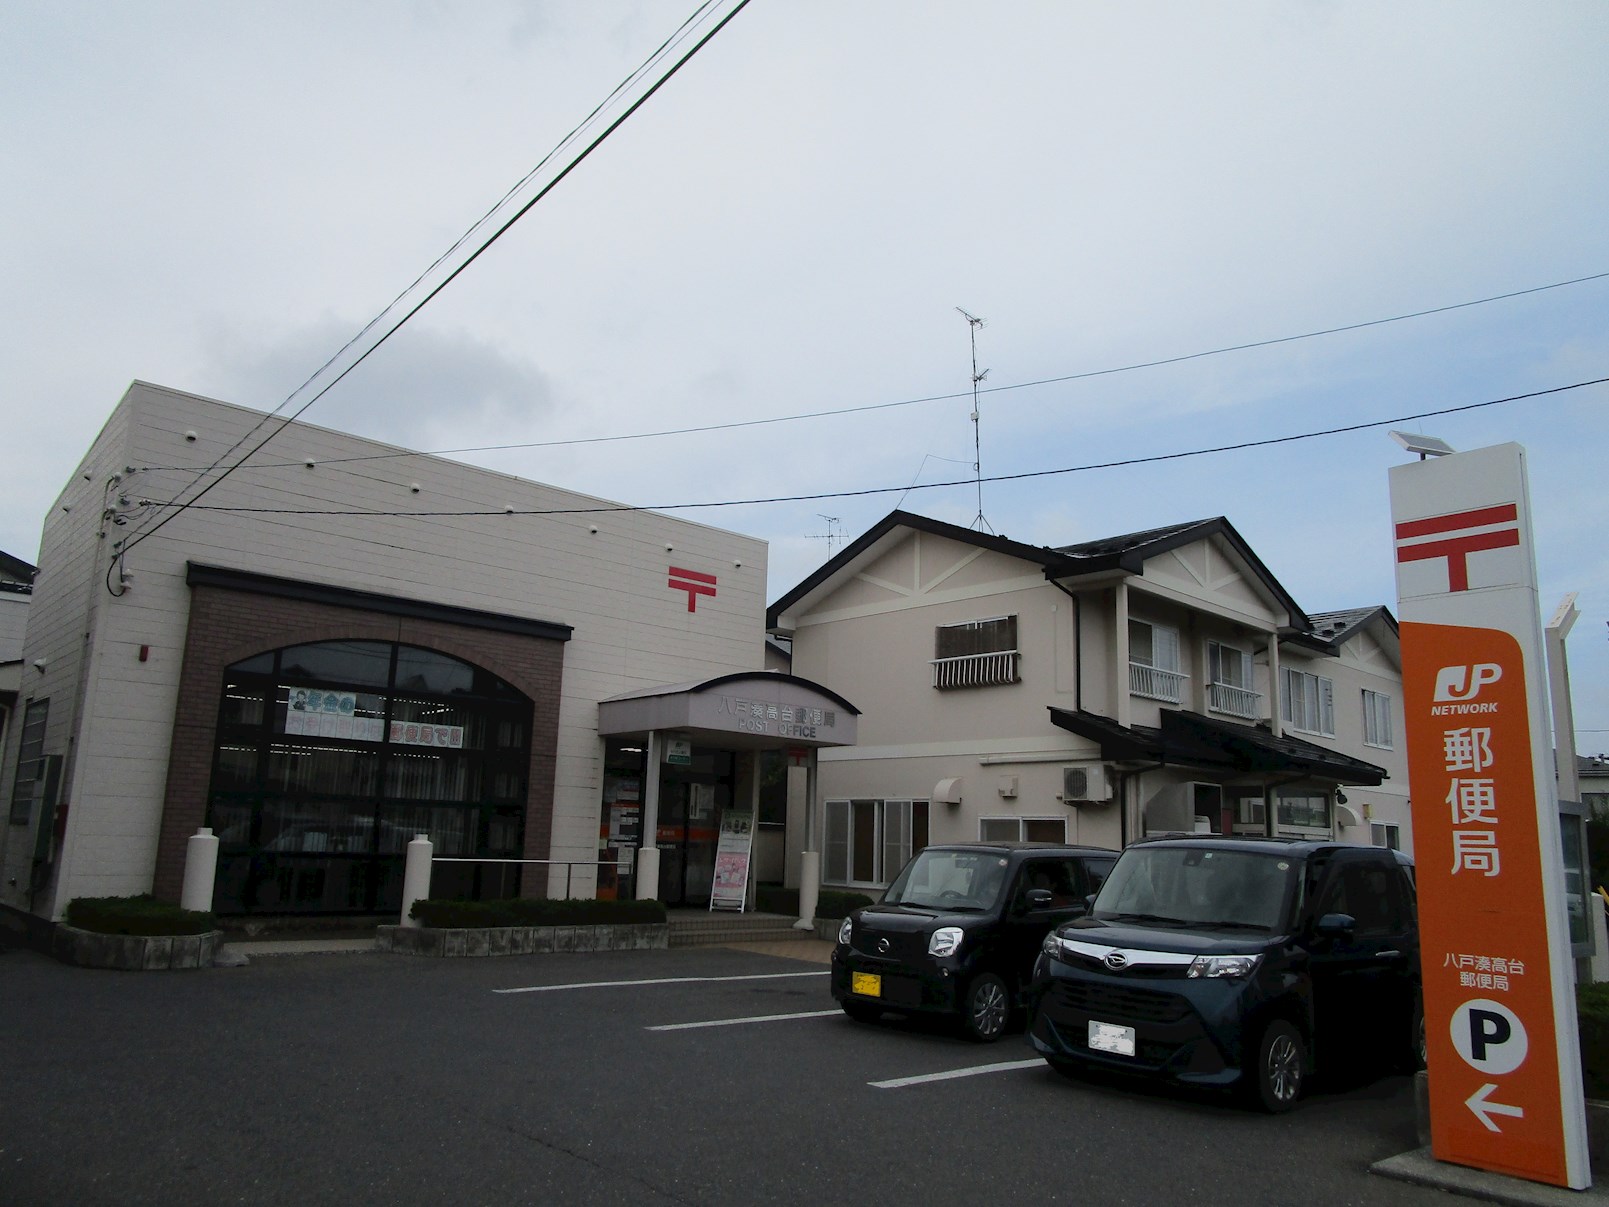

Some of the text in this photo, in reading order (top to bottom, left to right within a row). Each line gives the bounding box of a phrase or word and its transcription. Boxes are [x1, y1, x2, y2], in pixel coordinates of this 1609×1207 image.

[1433, 663, 1502, 701] JP
[718, 696, 835, 728] 八戸湊高台郵便局
[1431, 702, 1498, 716] NETWORK
[738, 719, 816, 738] POST OFFICE
[1443, 727, 1500, 877] 郵便局
[1443, 953, 1525, 975] 八戸湊高台
[1460, 971, 1509, 991] 郵便局
[1469, 1008, 1511, 1061] P
